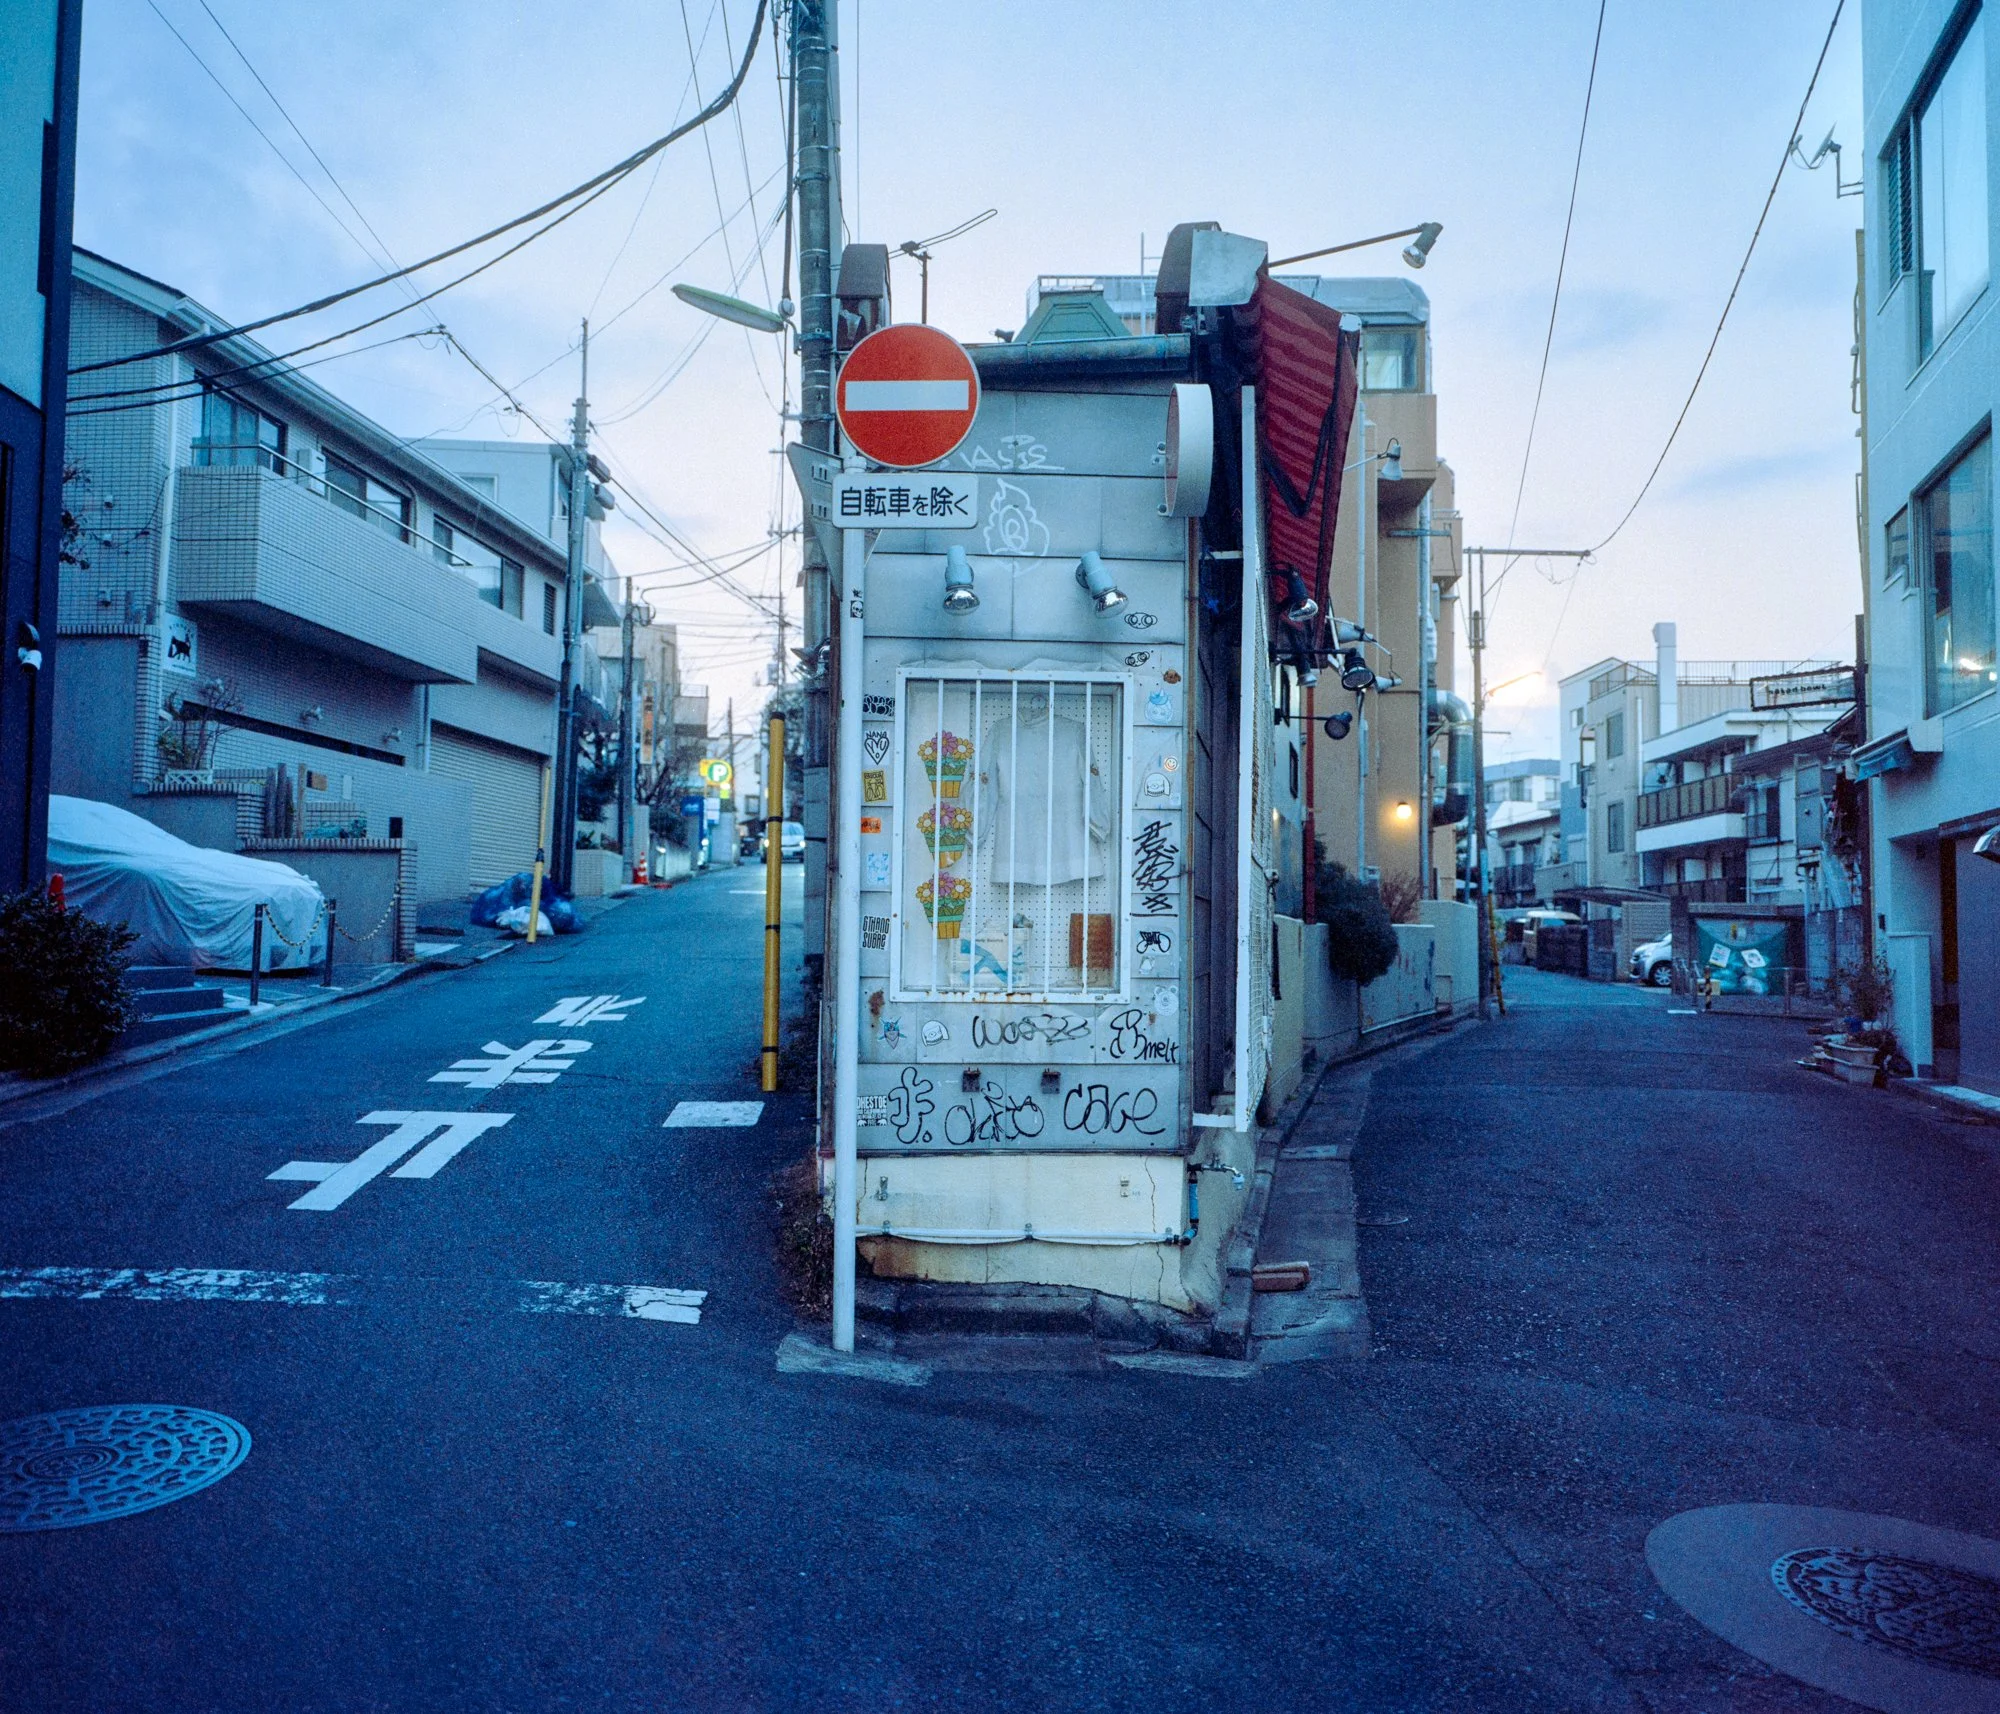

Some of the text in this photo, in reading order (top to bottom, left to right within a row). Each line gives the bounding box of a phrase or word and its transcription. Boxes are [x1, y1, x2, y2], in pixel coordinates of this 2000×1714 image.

[841, 486, 969, 517] 自転車を除く
[265, 994, 647, 1211] 止まれ
